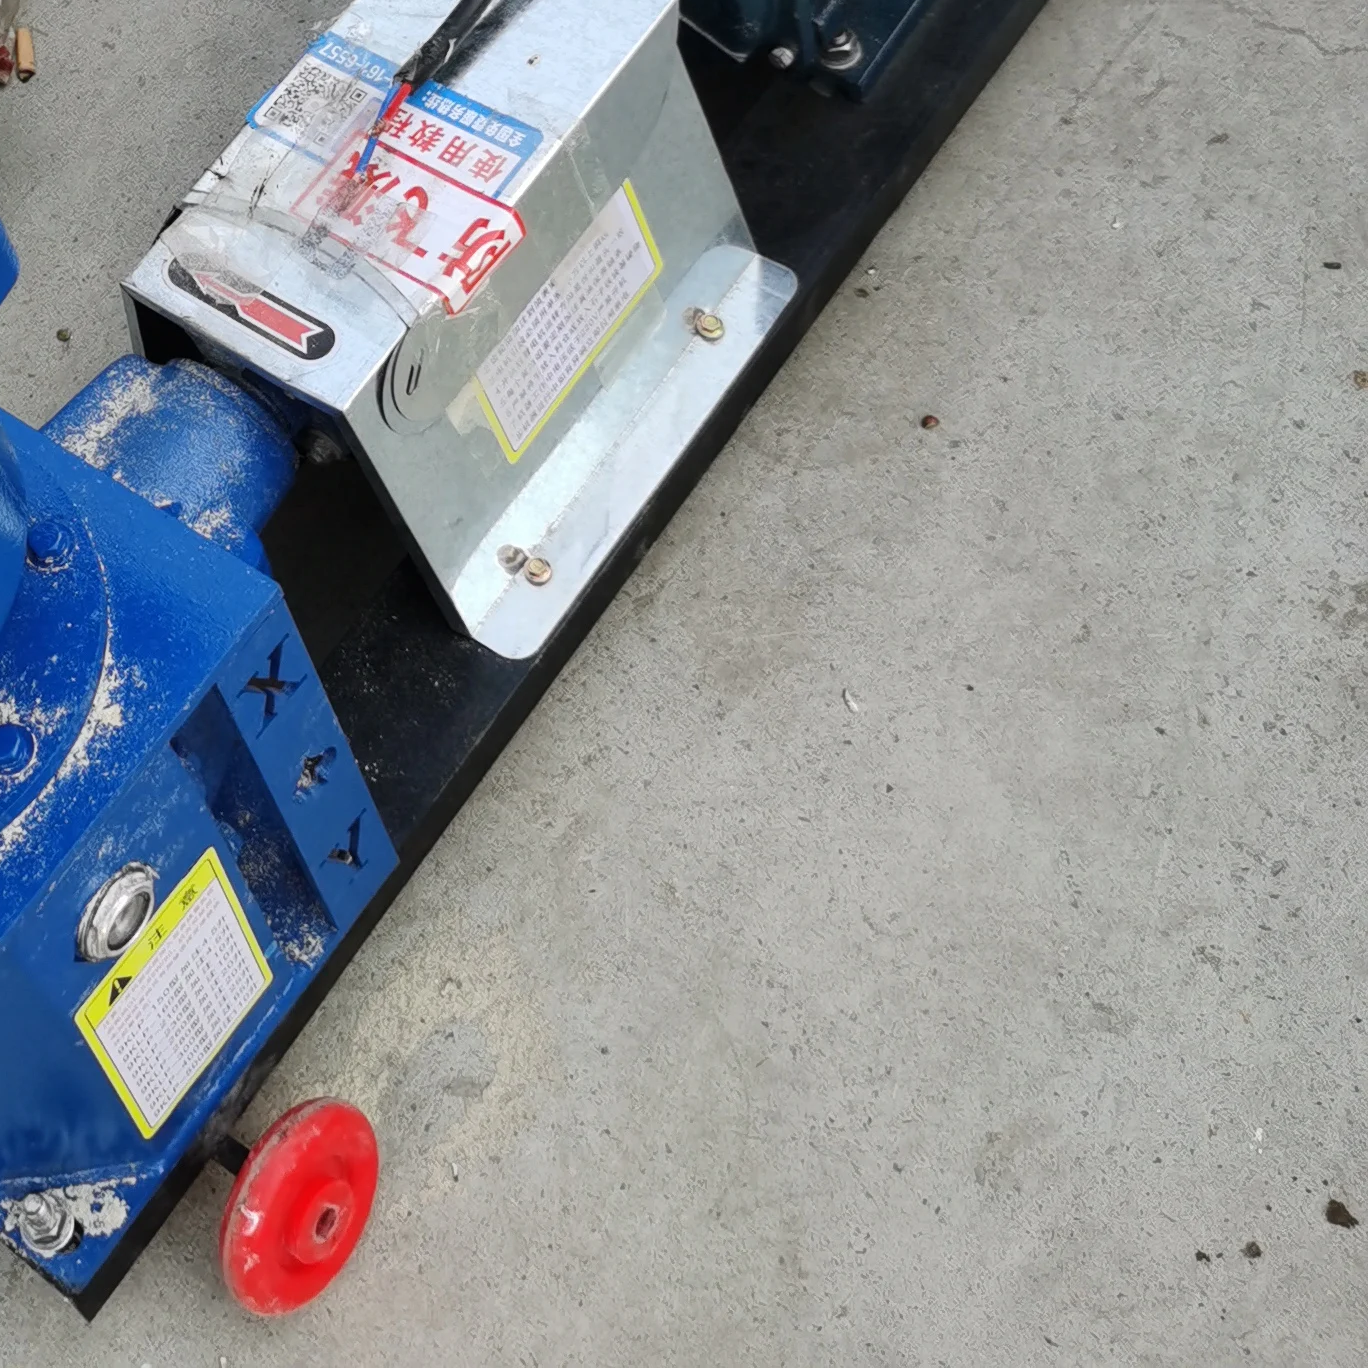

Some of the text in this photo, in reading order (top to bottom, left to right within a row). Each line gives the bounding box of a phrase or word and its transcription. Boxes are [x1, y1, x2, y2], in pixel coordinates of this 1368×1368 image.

[376, 106, 511, 185] 使用教程
[146, 880, 198, 950] 注意
